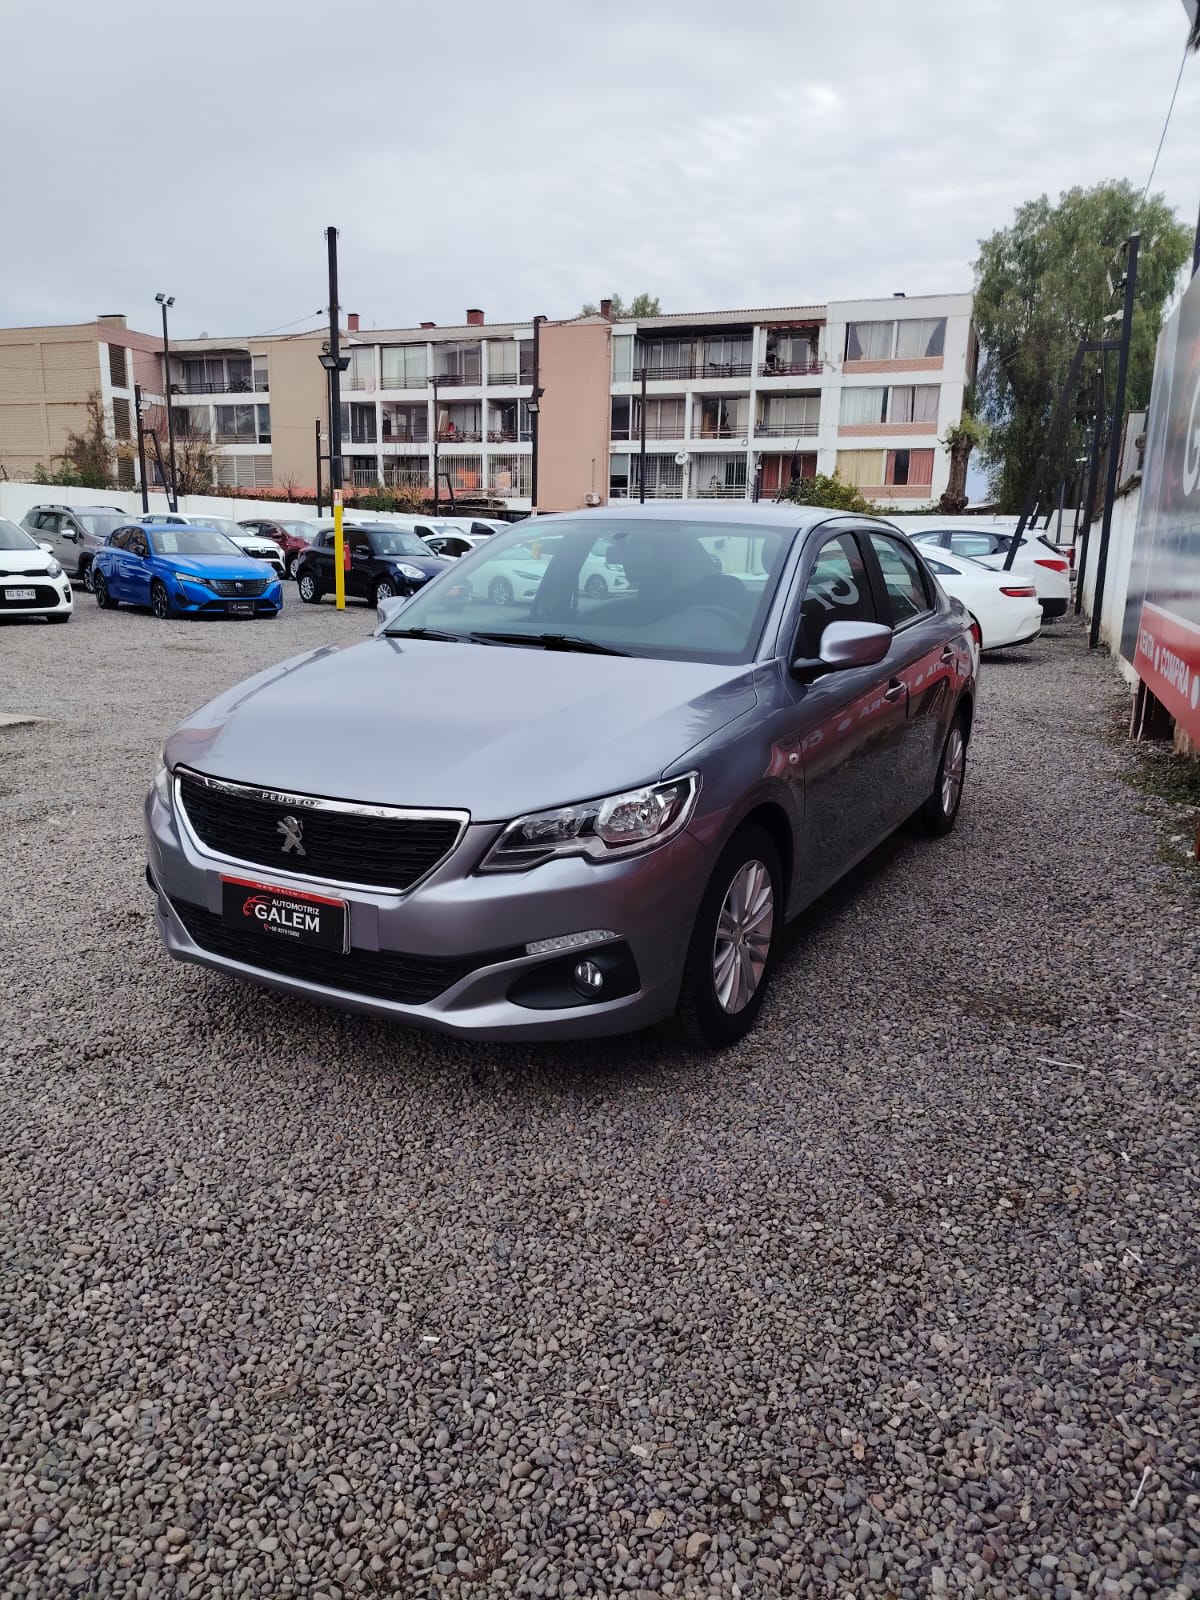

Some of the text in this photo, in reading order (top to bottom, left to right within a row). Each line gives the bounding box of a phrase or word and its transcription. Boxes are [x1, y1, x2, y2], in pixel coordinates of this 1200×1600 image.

[1160, 647, 1190, 699] COMPRA
[262, 792, 320, 808] PEUGEOT
[271, 898, 320, 915] AUTOMOTRIZ
[254, 904, 320, 933] GALEM
